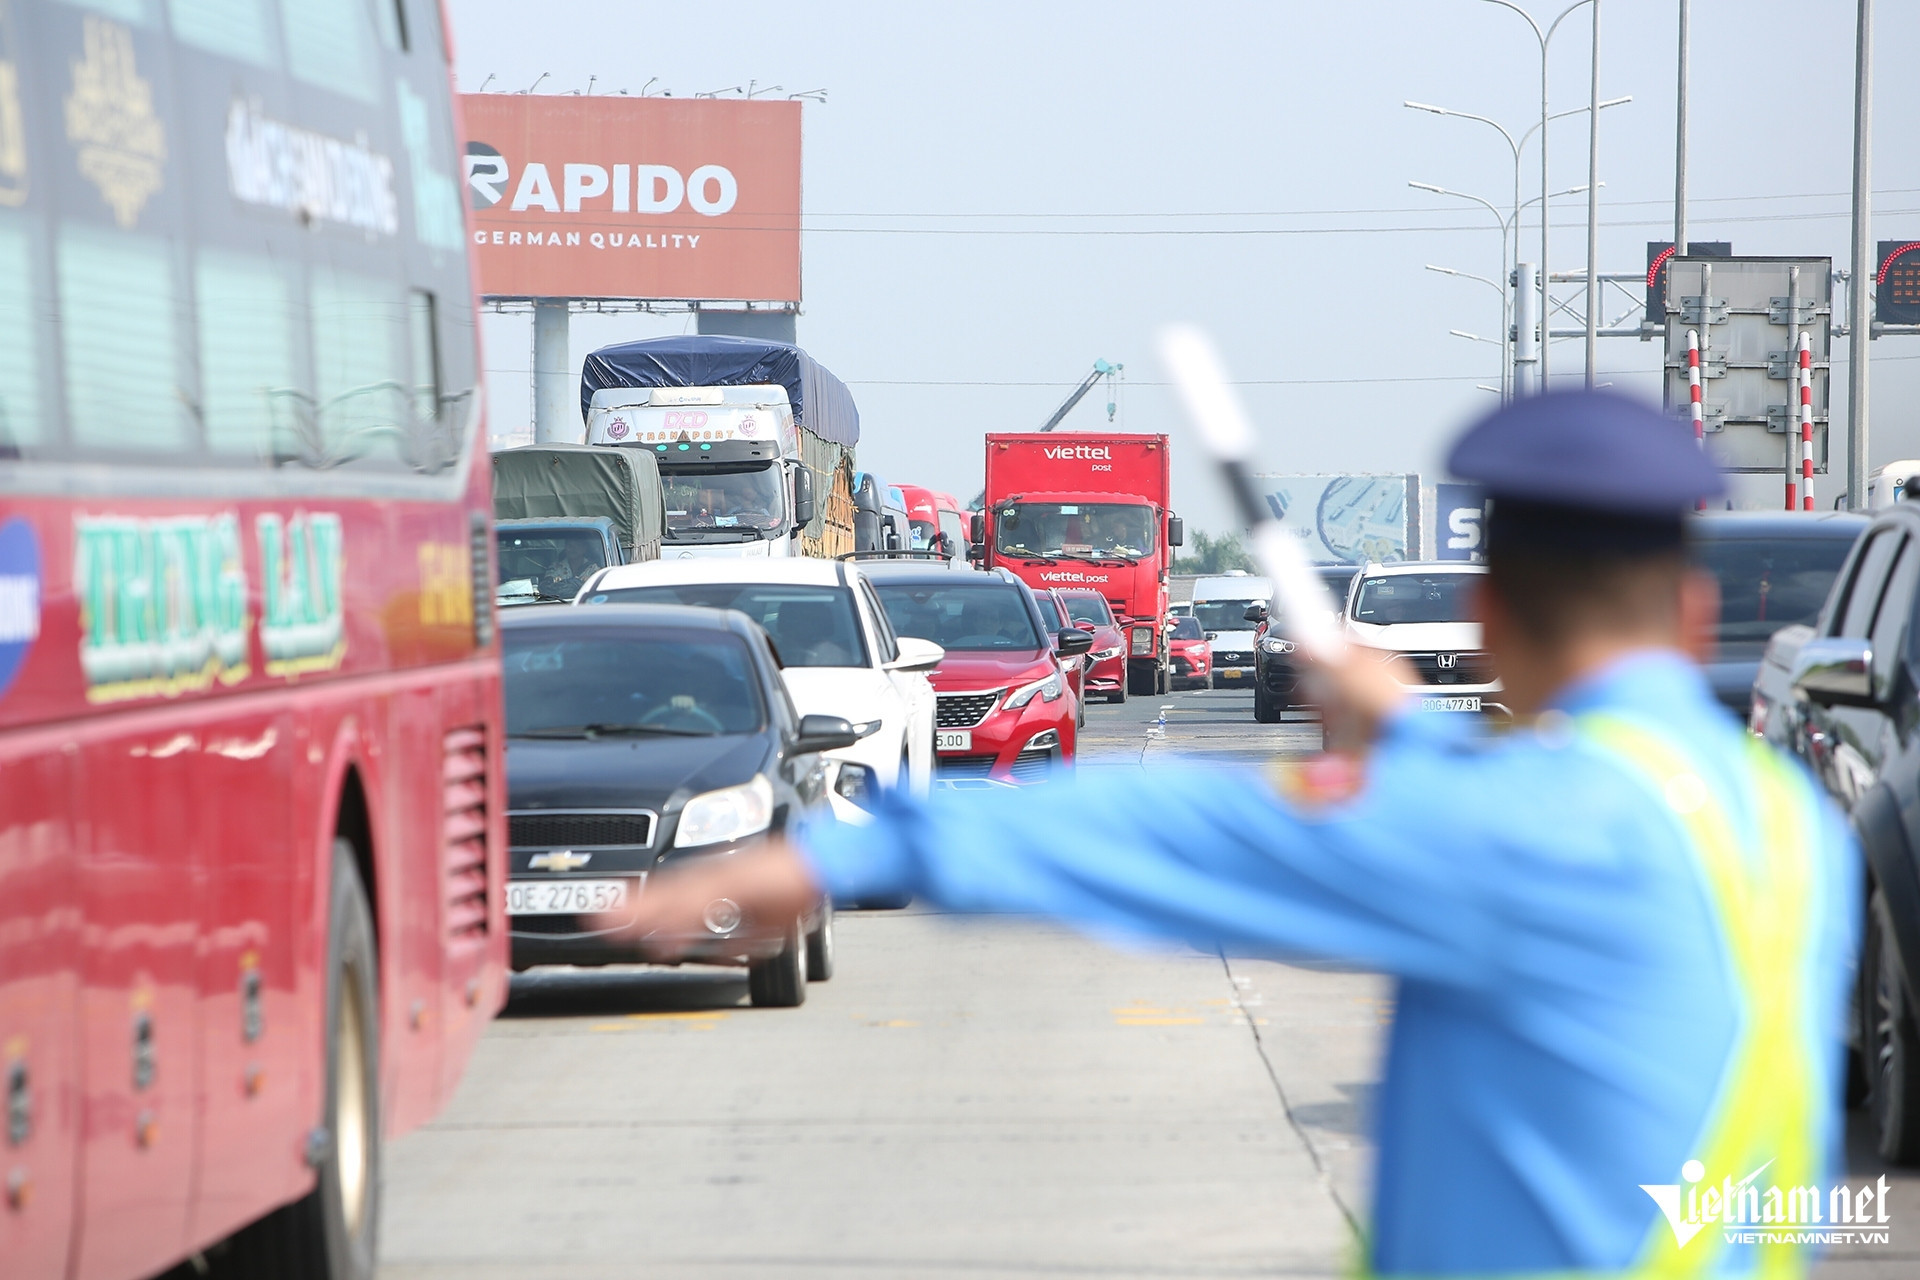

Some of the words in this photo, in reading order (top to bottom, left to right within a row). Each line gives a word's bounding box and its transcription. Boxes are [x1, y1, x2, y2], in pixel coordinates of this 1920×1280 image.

[465, 155, 738, 217] RAPIDO
[474, 230, 581, 247] GERMAN
[589, 231, 701, 249] QUALITY
[636, 430, 734, 441] TRANPORT
[1043, 445, 1112, 460] viettel
[1091, 464, 1112, 472] post
[1040, 571, 1085, 582] viettel
[1086, 574, 1109, 584] post
[1422, 699, 1479, 711] 30G-477.91
[504, 885, 622, 911] 0E-276.52
